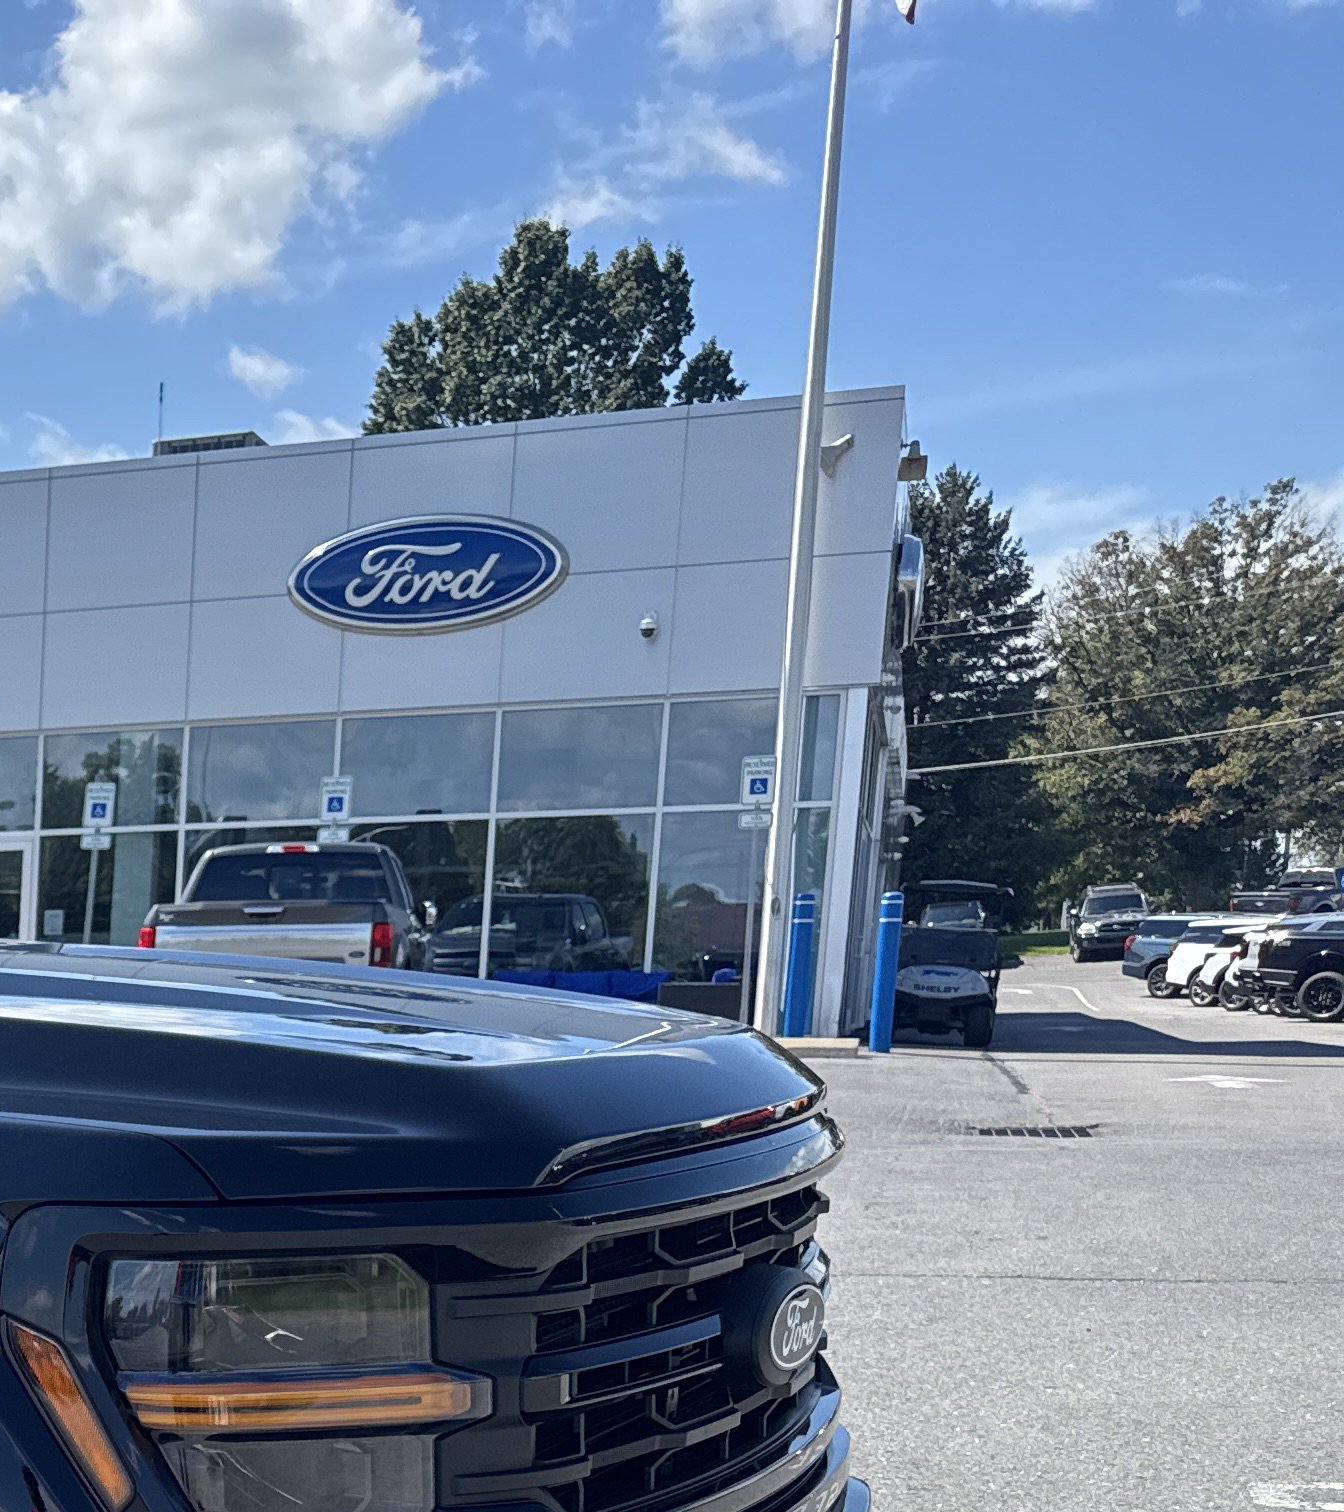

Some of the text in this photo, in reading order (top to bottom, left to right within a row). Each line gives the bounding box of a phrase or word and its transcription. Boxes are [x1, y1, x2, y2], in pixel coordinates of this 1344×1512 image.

[344, 542, 502, 608] Ford
[913, 983, 961, 994] SHELBY
[782, 1297, 818, 1357] Ford
